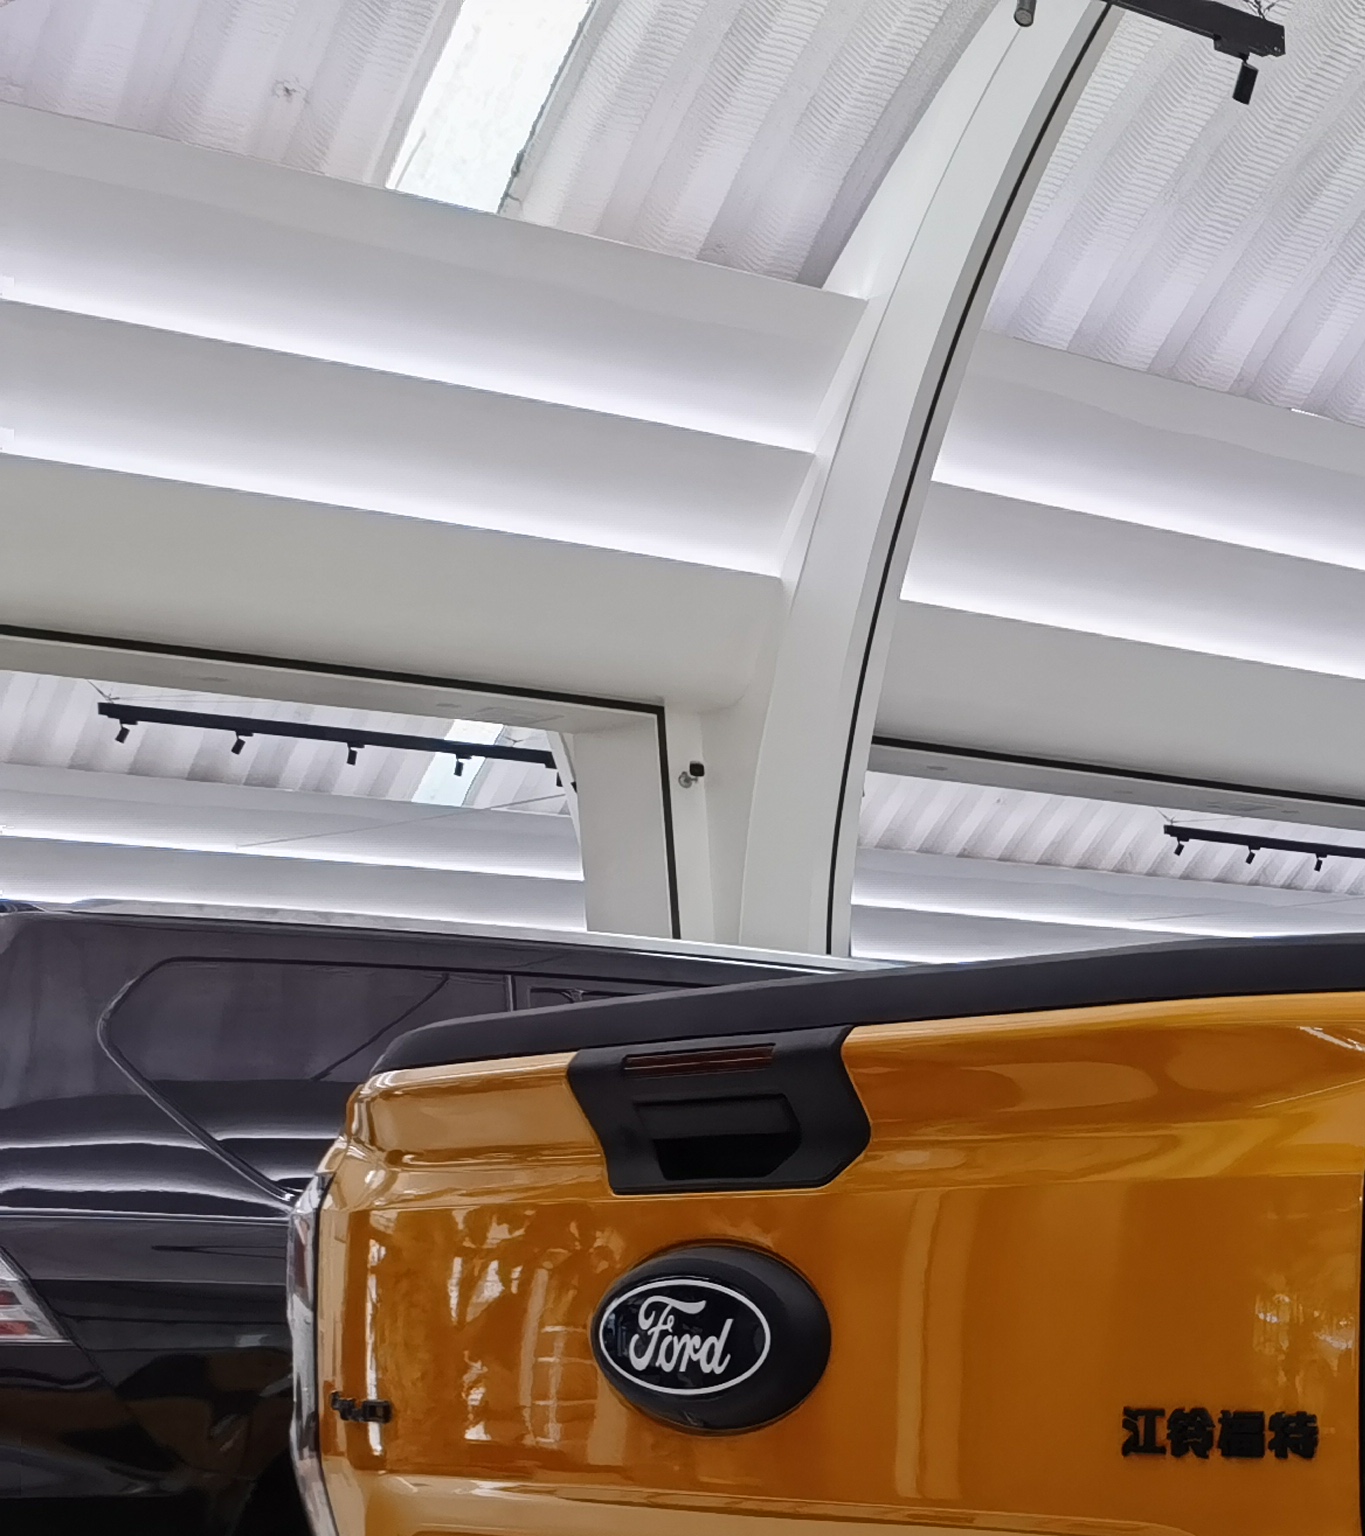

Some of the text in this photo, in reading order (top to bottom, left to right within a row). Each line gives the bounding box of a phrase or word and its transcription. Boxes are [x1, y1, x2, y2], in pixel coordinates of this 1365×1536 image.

[628, 1294, 735, 1375] Ford
[1121, 1406, 1320, 1460] 江铃福特
